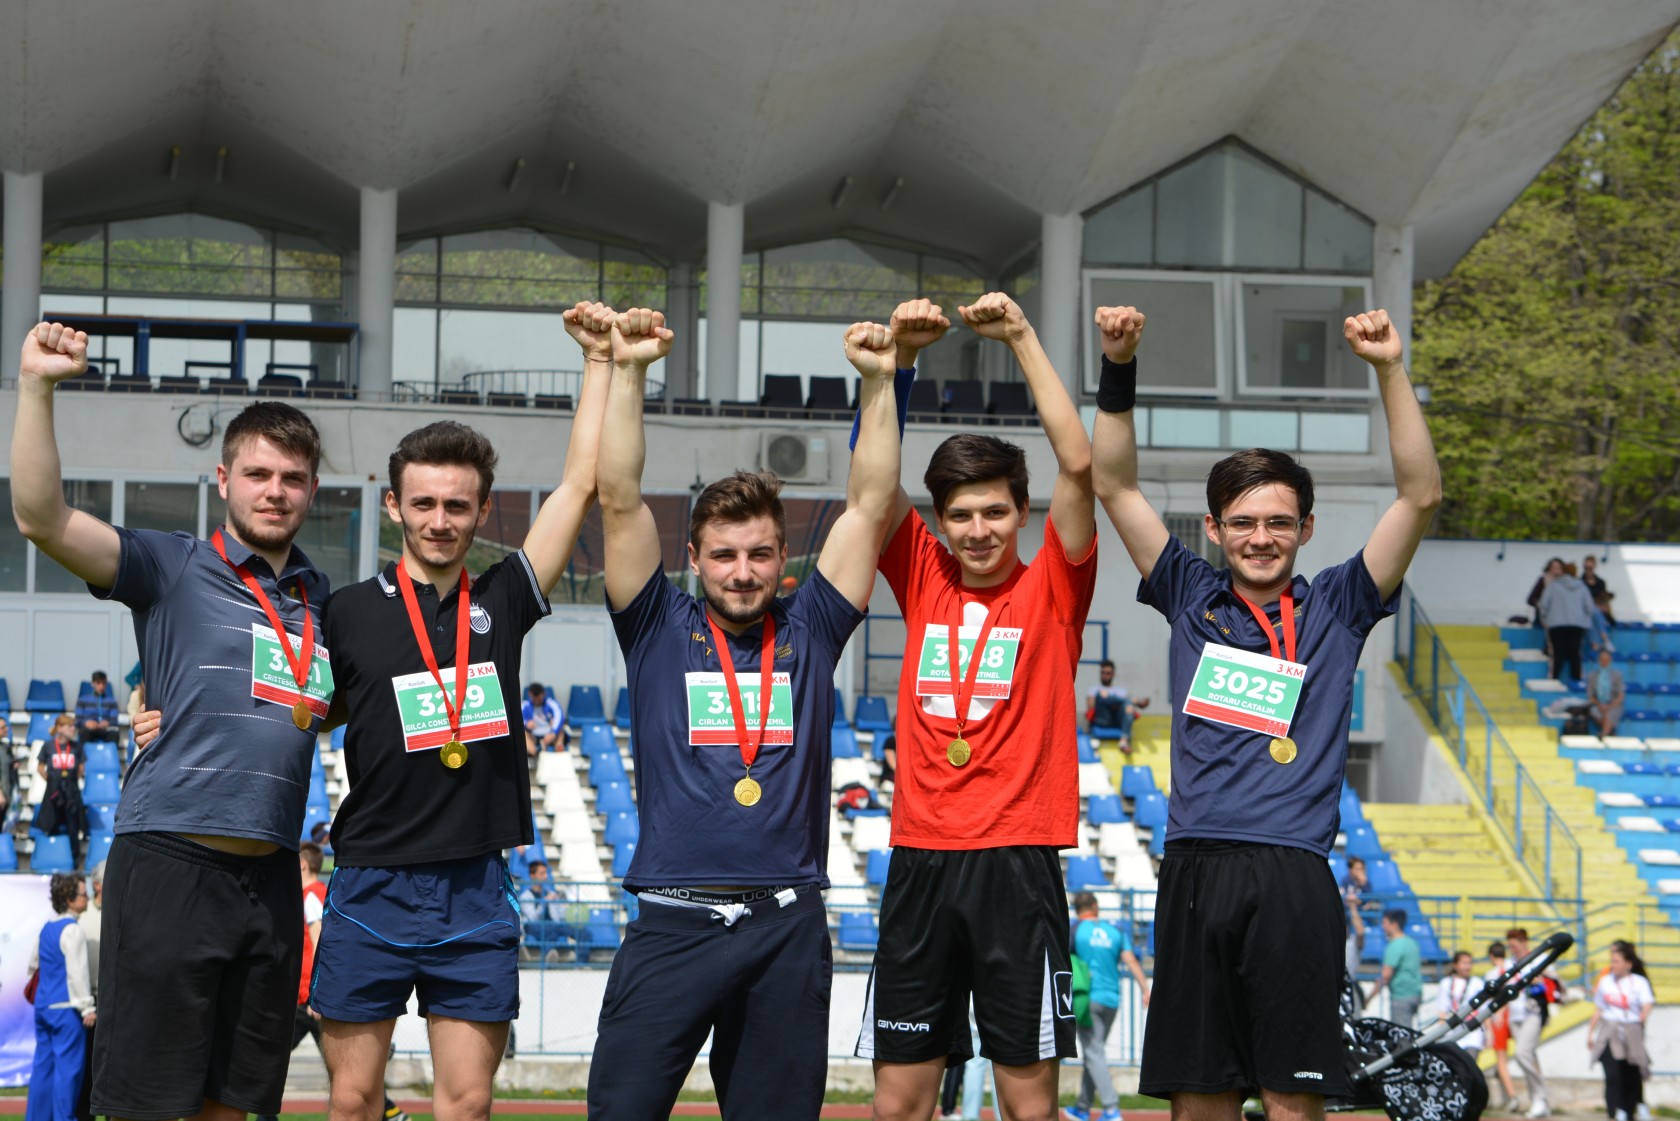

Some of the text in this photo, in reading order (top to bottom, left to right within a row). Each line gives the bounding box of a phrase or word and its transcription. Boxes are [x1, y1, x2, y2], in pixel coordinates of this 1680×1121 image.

[994, 630, 1019, 639] 3 KM
[317, 648, 329, 661] KM
[468, 665, 496, 678] 3 KM
[929, 669, 952, 677] ROTA
[1276, 663, 1304, 678] 3 KM
[771, 676, 789, 685] KM
[1207, 665, 1287, 705] 3025
[416, 684, 485, 718] 329
[1207, 692, 1276, 715] ROTARU CATALIN
[405, 721, 427, 732] GILCA
[698, 718, 729, 726] CIRLAN
[690, 895, 733, 905] UNDERWEAR
[877, 1019, 930, 1032] GIVOVA
